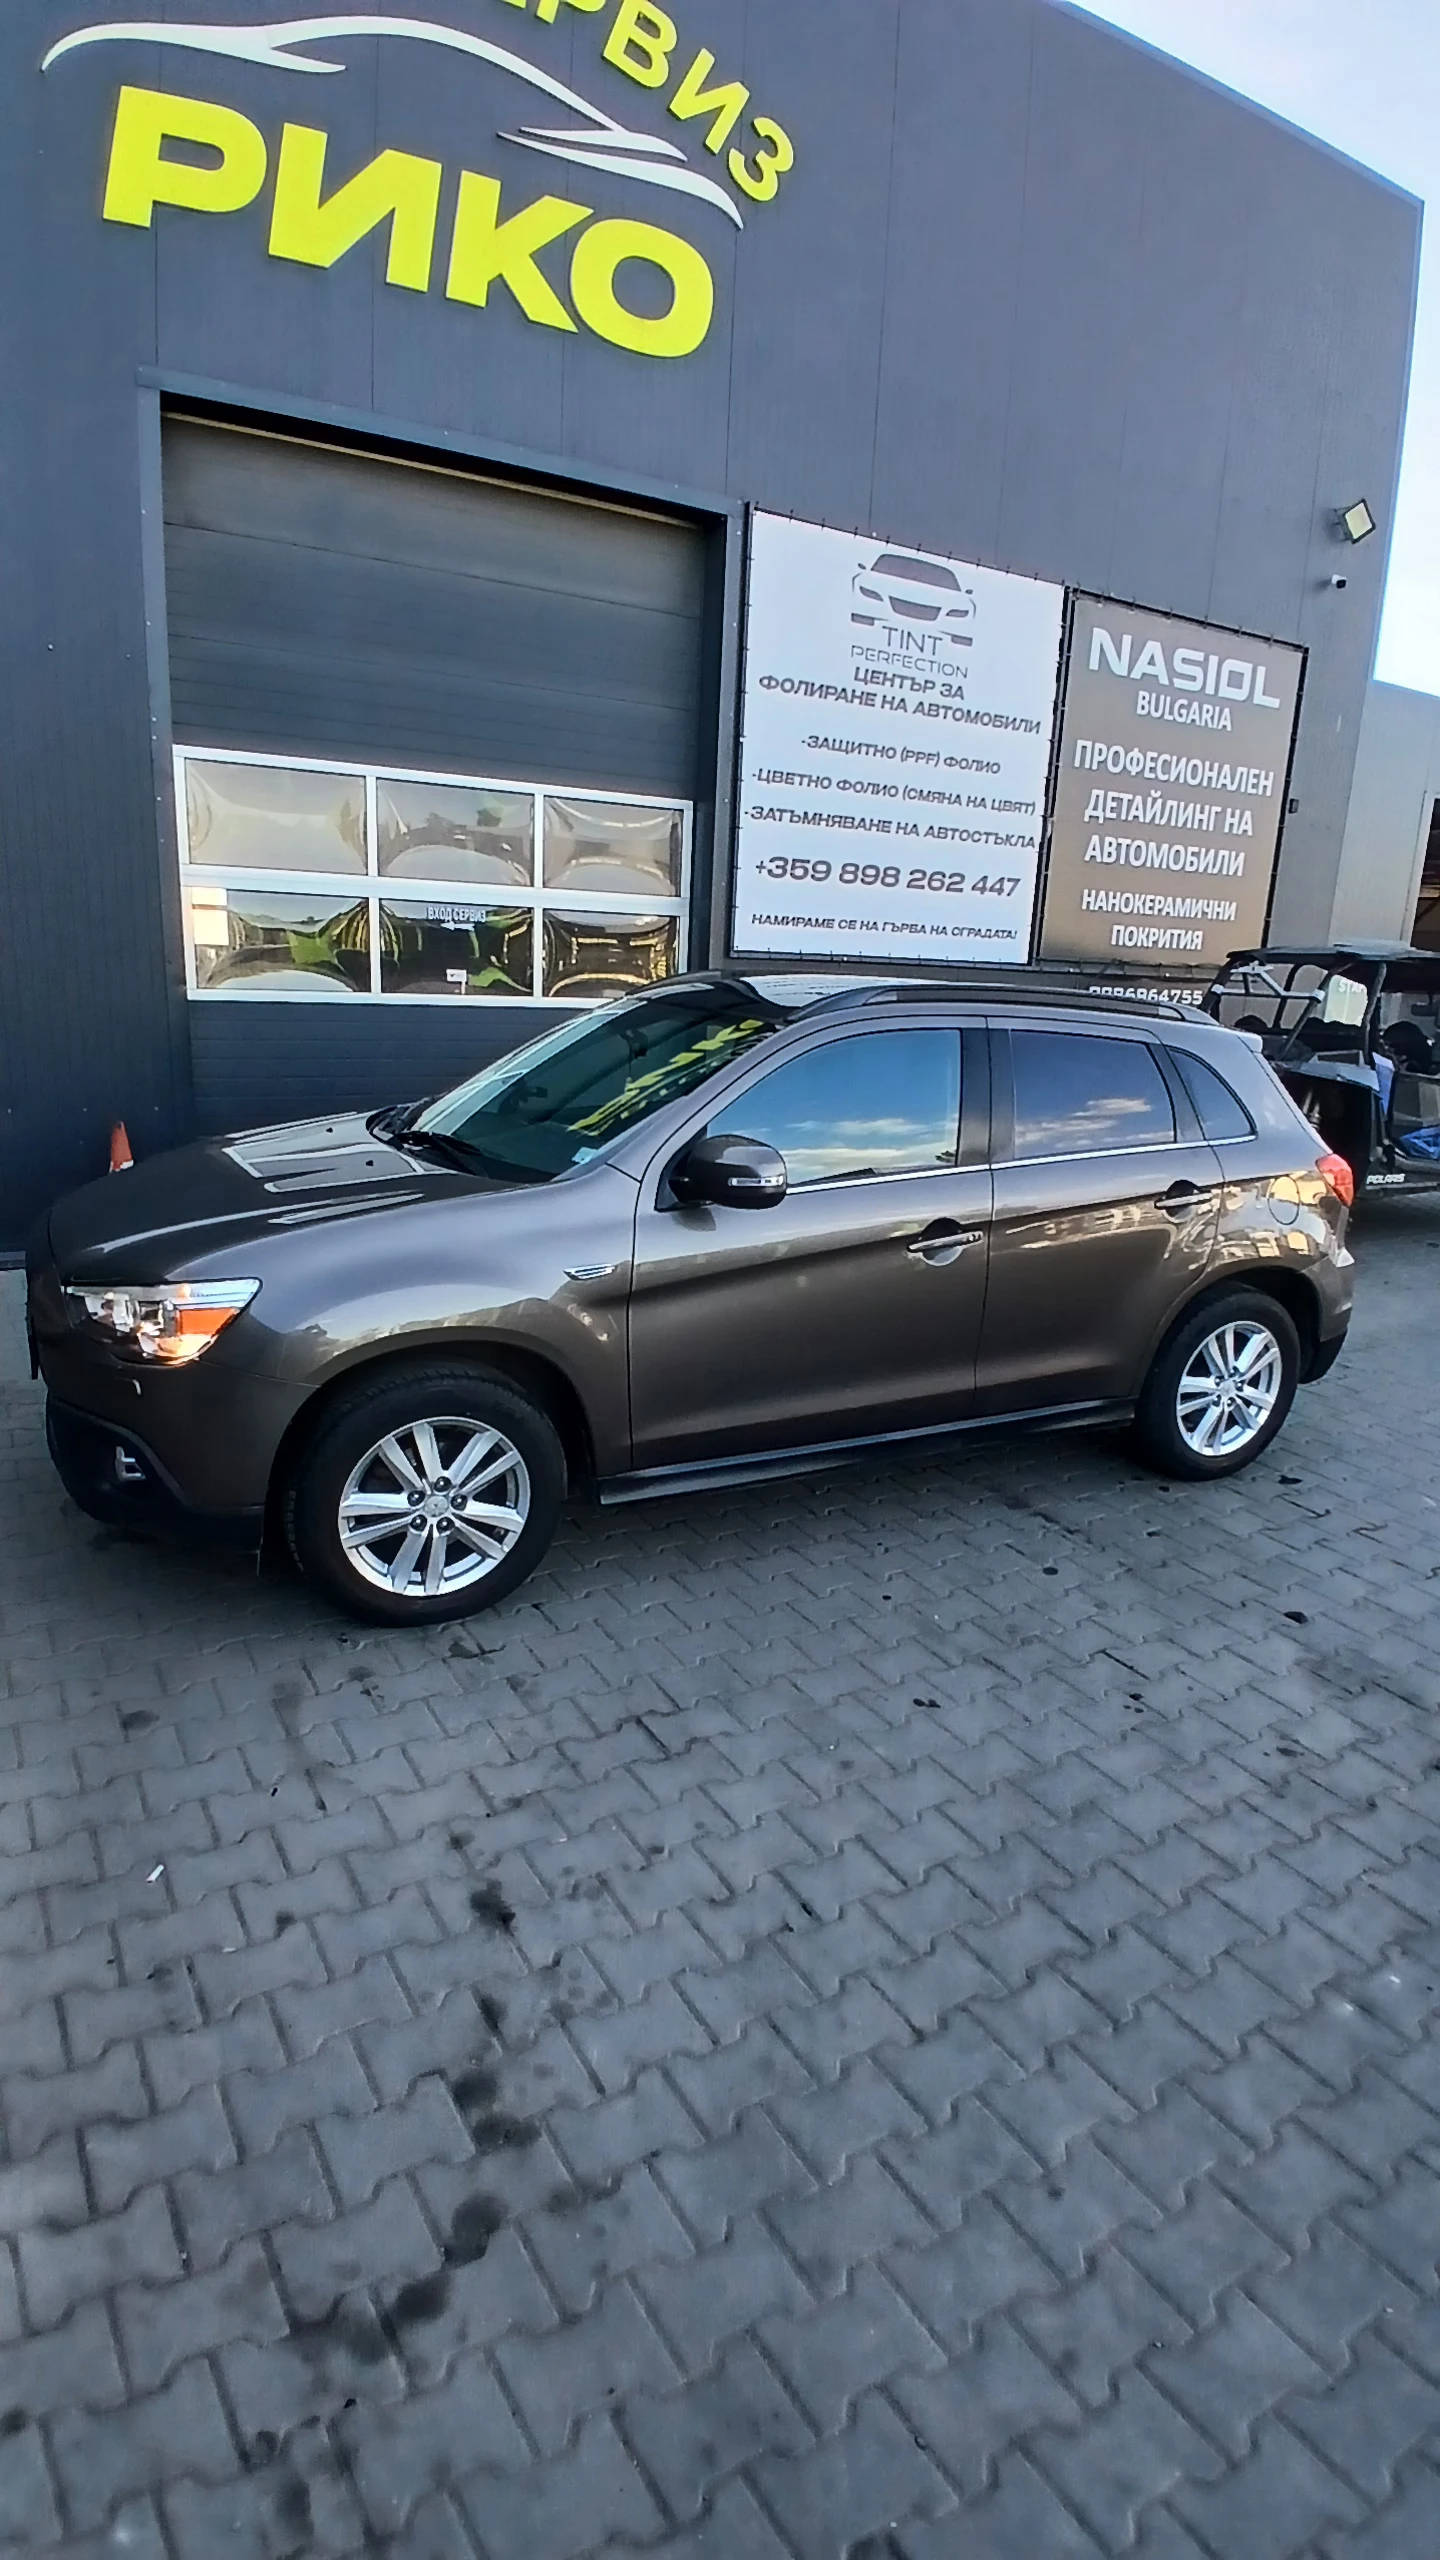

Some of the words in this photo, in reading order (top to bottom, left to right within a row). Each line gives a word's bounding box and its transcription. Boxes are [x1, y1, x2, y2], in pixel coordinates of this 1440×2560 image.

[103, 84, 715, 358] РИКО
[882, 625, 943, 656] TINT
[851, 645, 968, 679] PERFECTION
[1088, 627, 1280, 709] NASIOL
[854, 666, 936, 694] ЦЕНТЪР
[940, 682, 965, 701] ЗА
[758, 674, 878, 708] ФОЛИРАНЕ
[880, 694, 908, 713] НА
[912, 700, 1042, 735] АВТОМОБИЛИ
[1136, 690, 1233, 732] BULGARIA
[801, 735, 897, 760] -ЗАЩИТНО
[900, 746, 941, 767] (PPF)
[943, 755, 1002, 775] ФОЛИО
[1074, 739, 1275, 797] ПРОФЕСИОНАЛЕН
[752, 768, 832, 790] -ЦВЕТНО
[836, 779, 899, 799] ФОЛИО
[902, 784, 963, 807] (СМЯНА
[965, 795, 988, 810] НА
[990, 798, 1036, 816] ЦВЯТ)
[744, 805, 893, 834] -ЗАТЪМНЯВАНЕ
[895, 821, 920, 837] НА
[923, 825, 1036, 849] АВТОСТЪКЛА
[1083, 789, 1222, 832] ДЕТАЙЛИНГ
[1223, 807, 1253, 837] НА
[1084, 834, 1246, 877] АВТОМОБИЛИ
[755, 856, 832, 882] +359
[838, 862, 901, 888] 898
[906, 868, 966, 894] 262
[971, 875, 1021, 897] 447
[428, 906, 452, 922] ВХОД
[752, 913, 836, 930] НАМИРАМЕ
[838, 919, 858, 931] СЕ
[860, 920, 880, 932] НА
[882, 922, 928, 935] ГЪРБА
[930, 925, 949, 937] НА
[1081, 888, 1238, 921] НАНОКЕРАМИЧНИ
[1110, 924, 1205, 951] ПОКРИТИЯ
